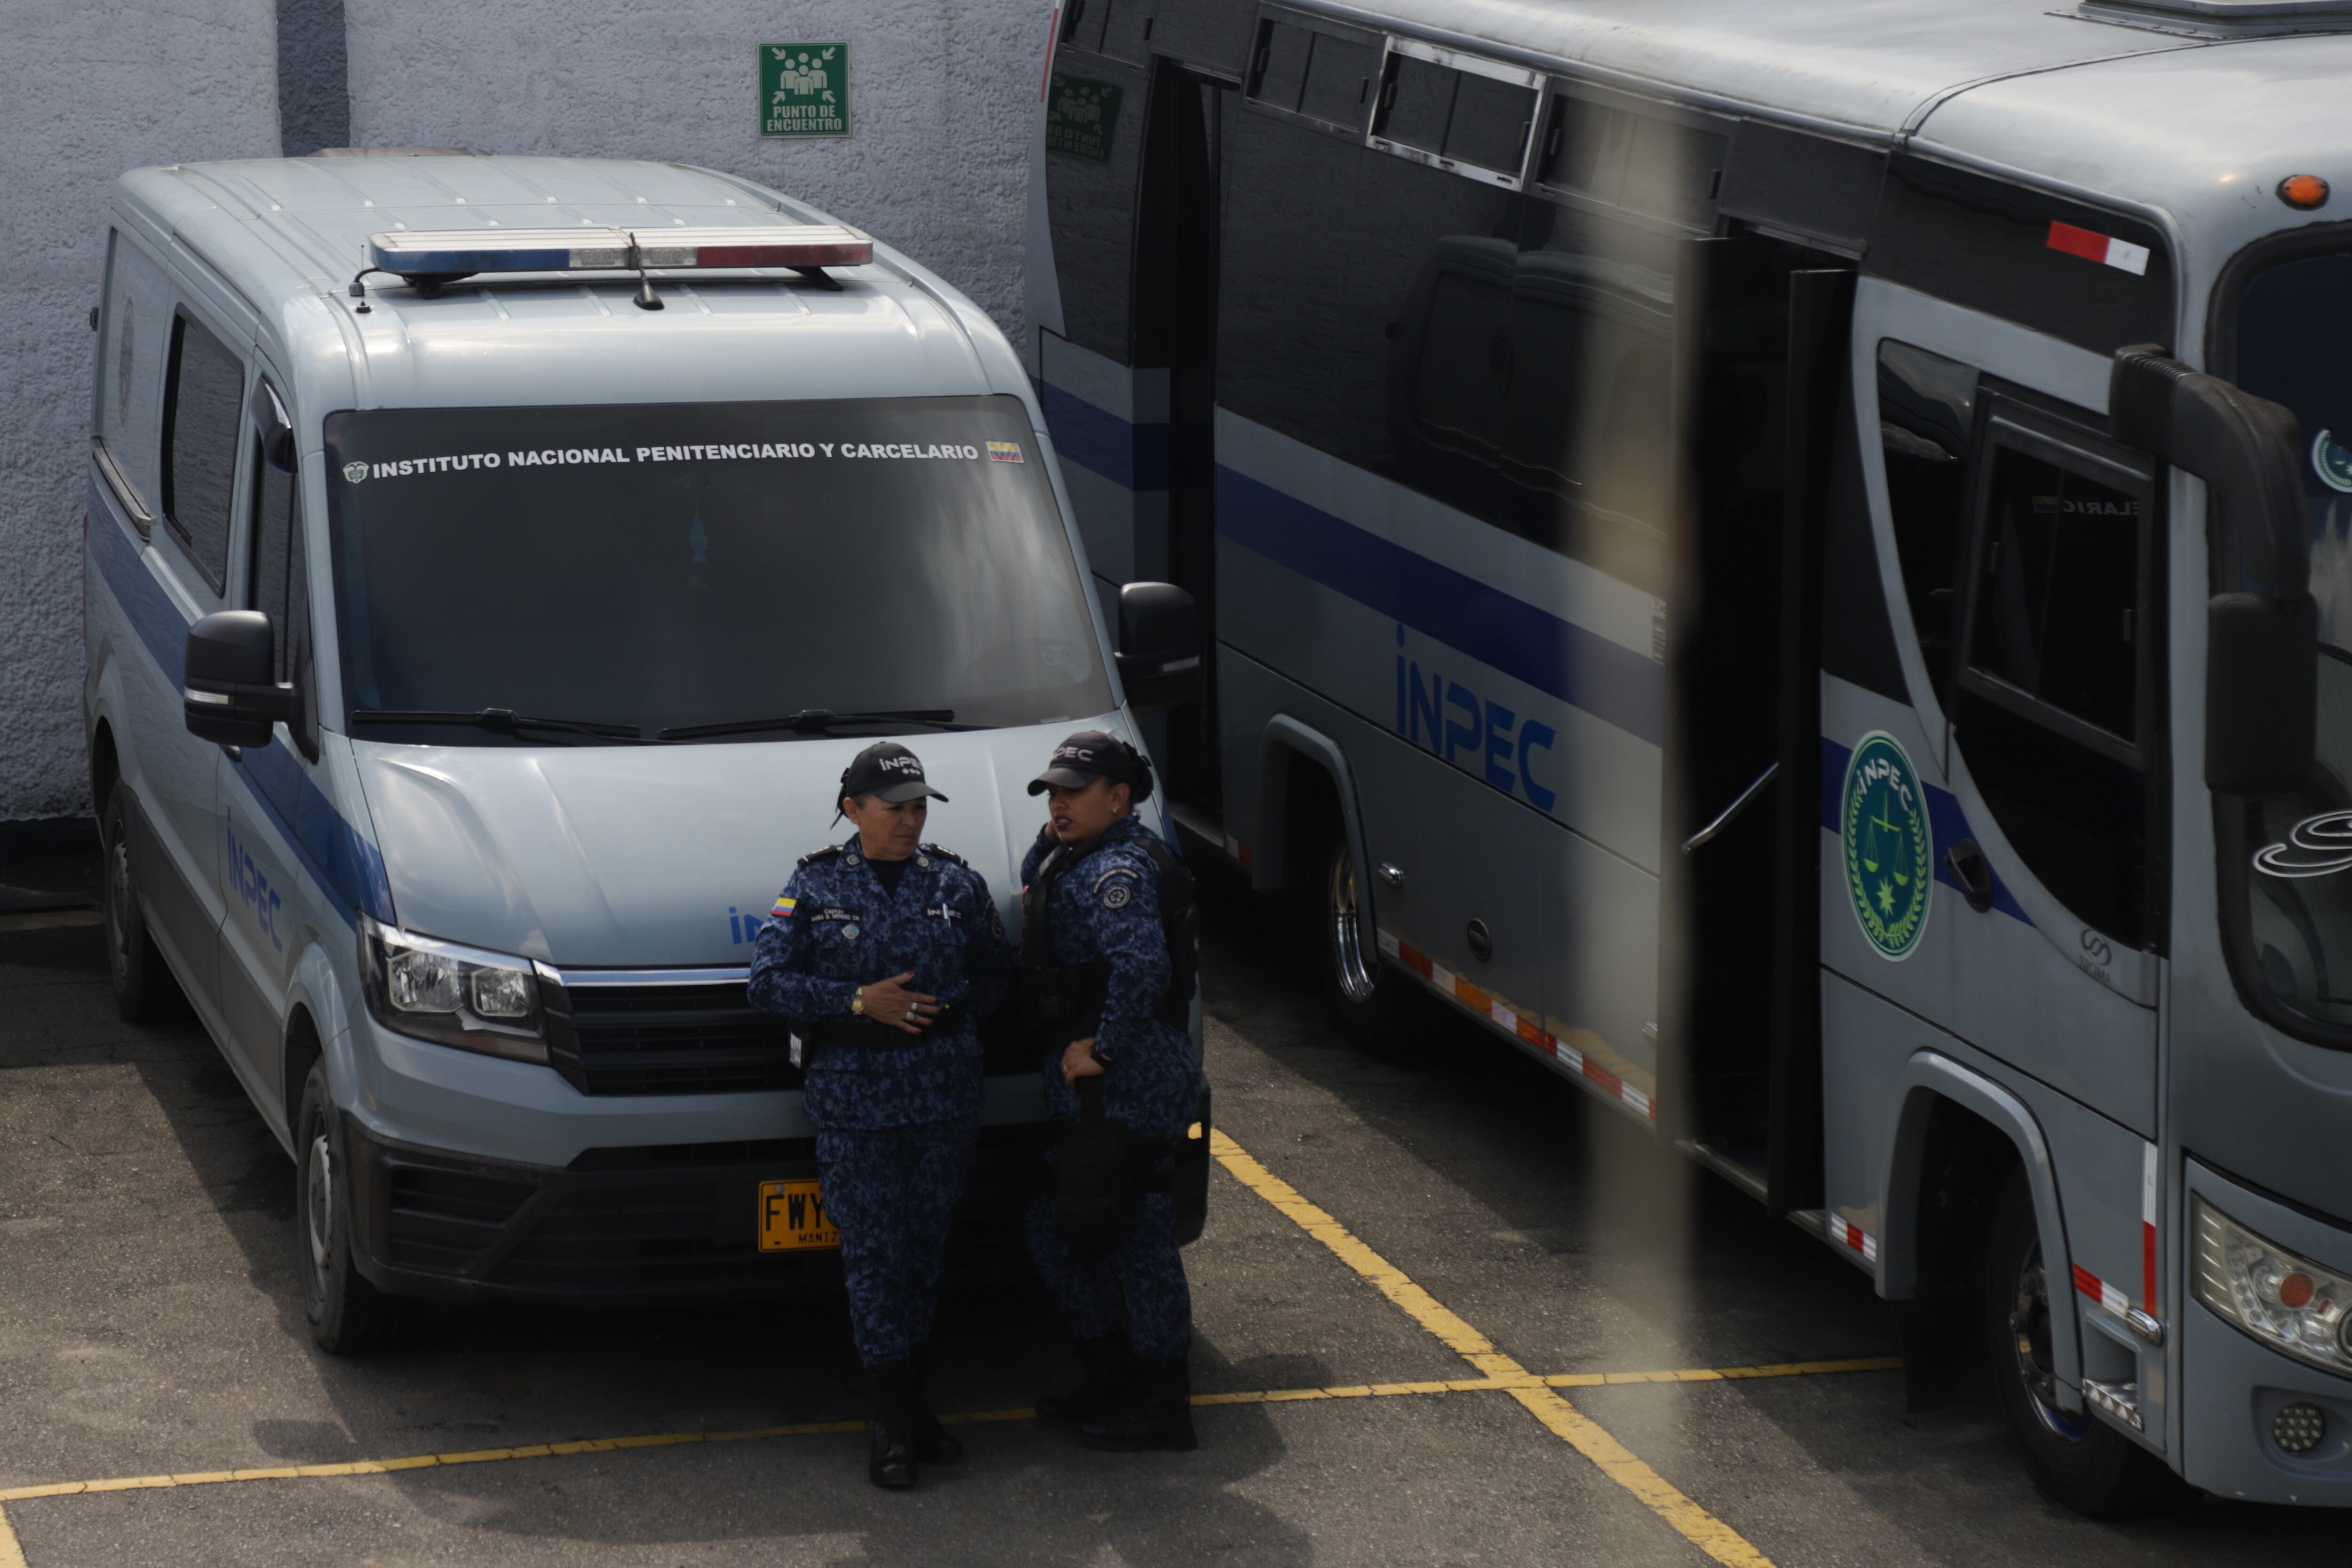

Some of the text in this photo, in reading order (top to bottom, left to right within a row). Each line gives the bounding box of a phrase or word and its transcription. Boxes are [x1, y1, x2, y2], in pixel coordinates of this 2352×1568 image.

[773, 105, 836, 118] PUNTO DE
[767, 118, 842, 131] ENCUENTRO
[373, 443, 978, 479] INSTITUTO NACIONAL PENITENCIARIO Y CARCELARIO
